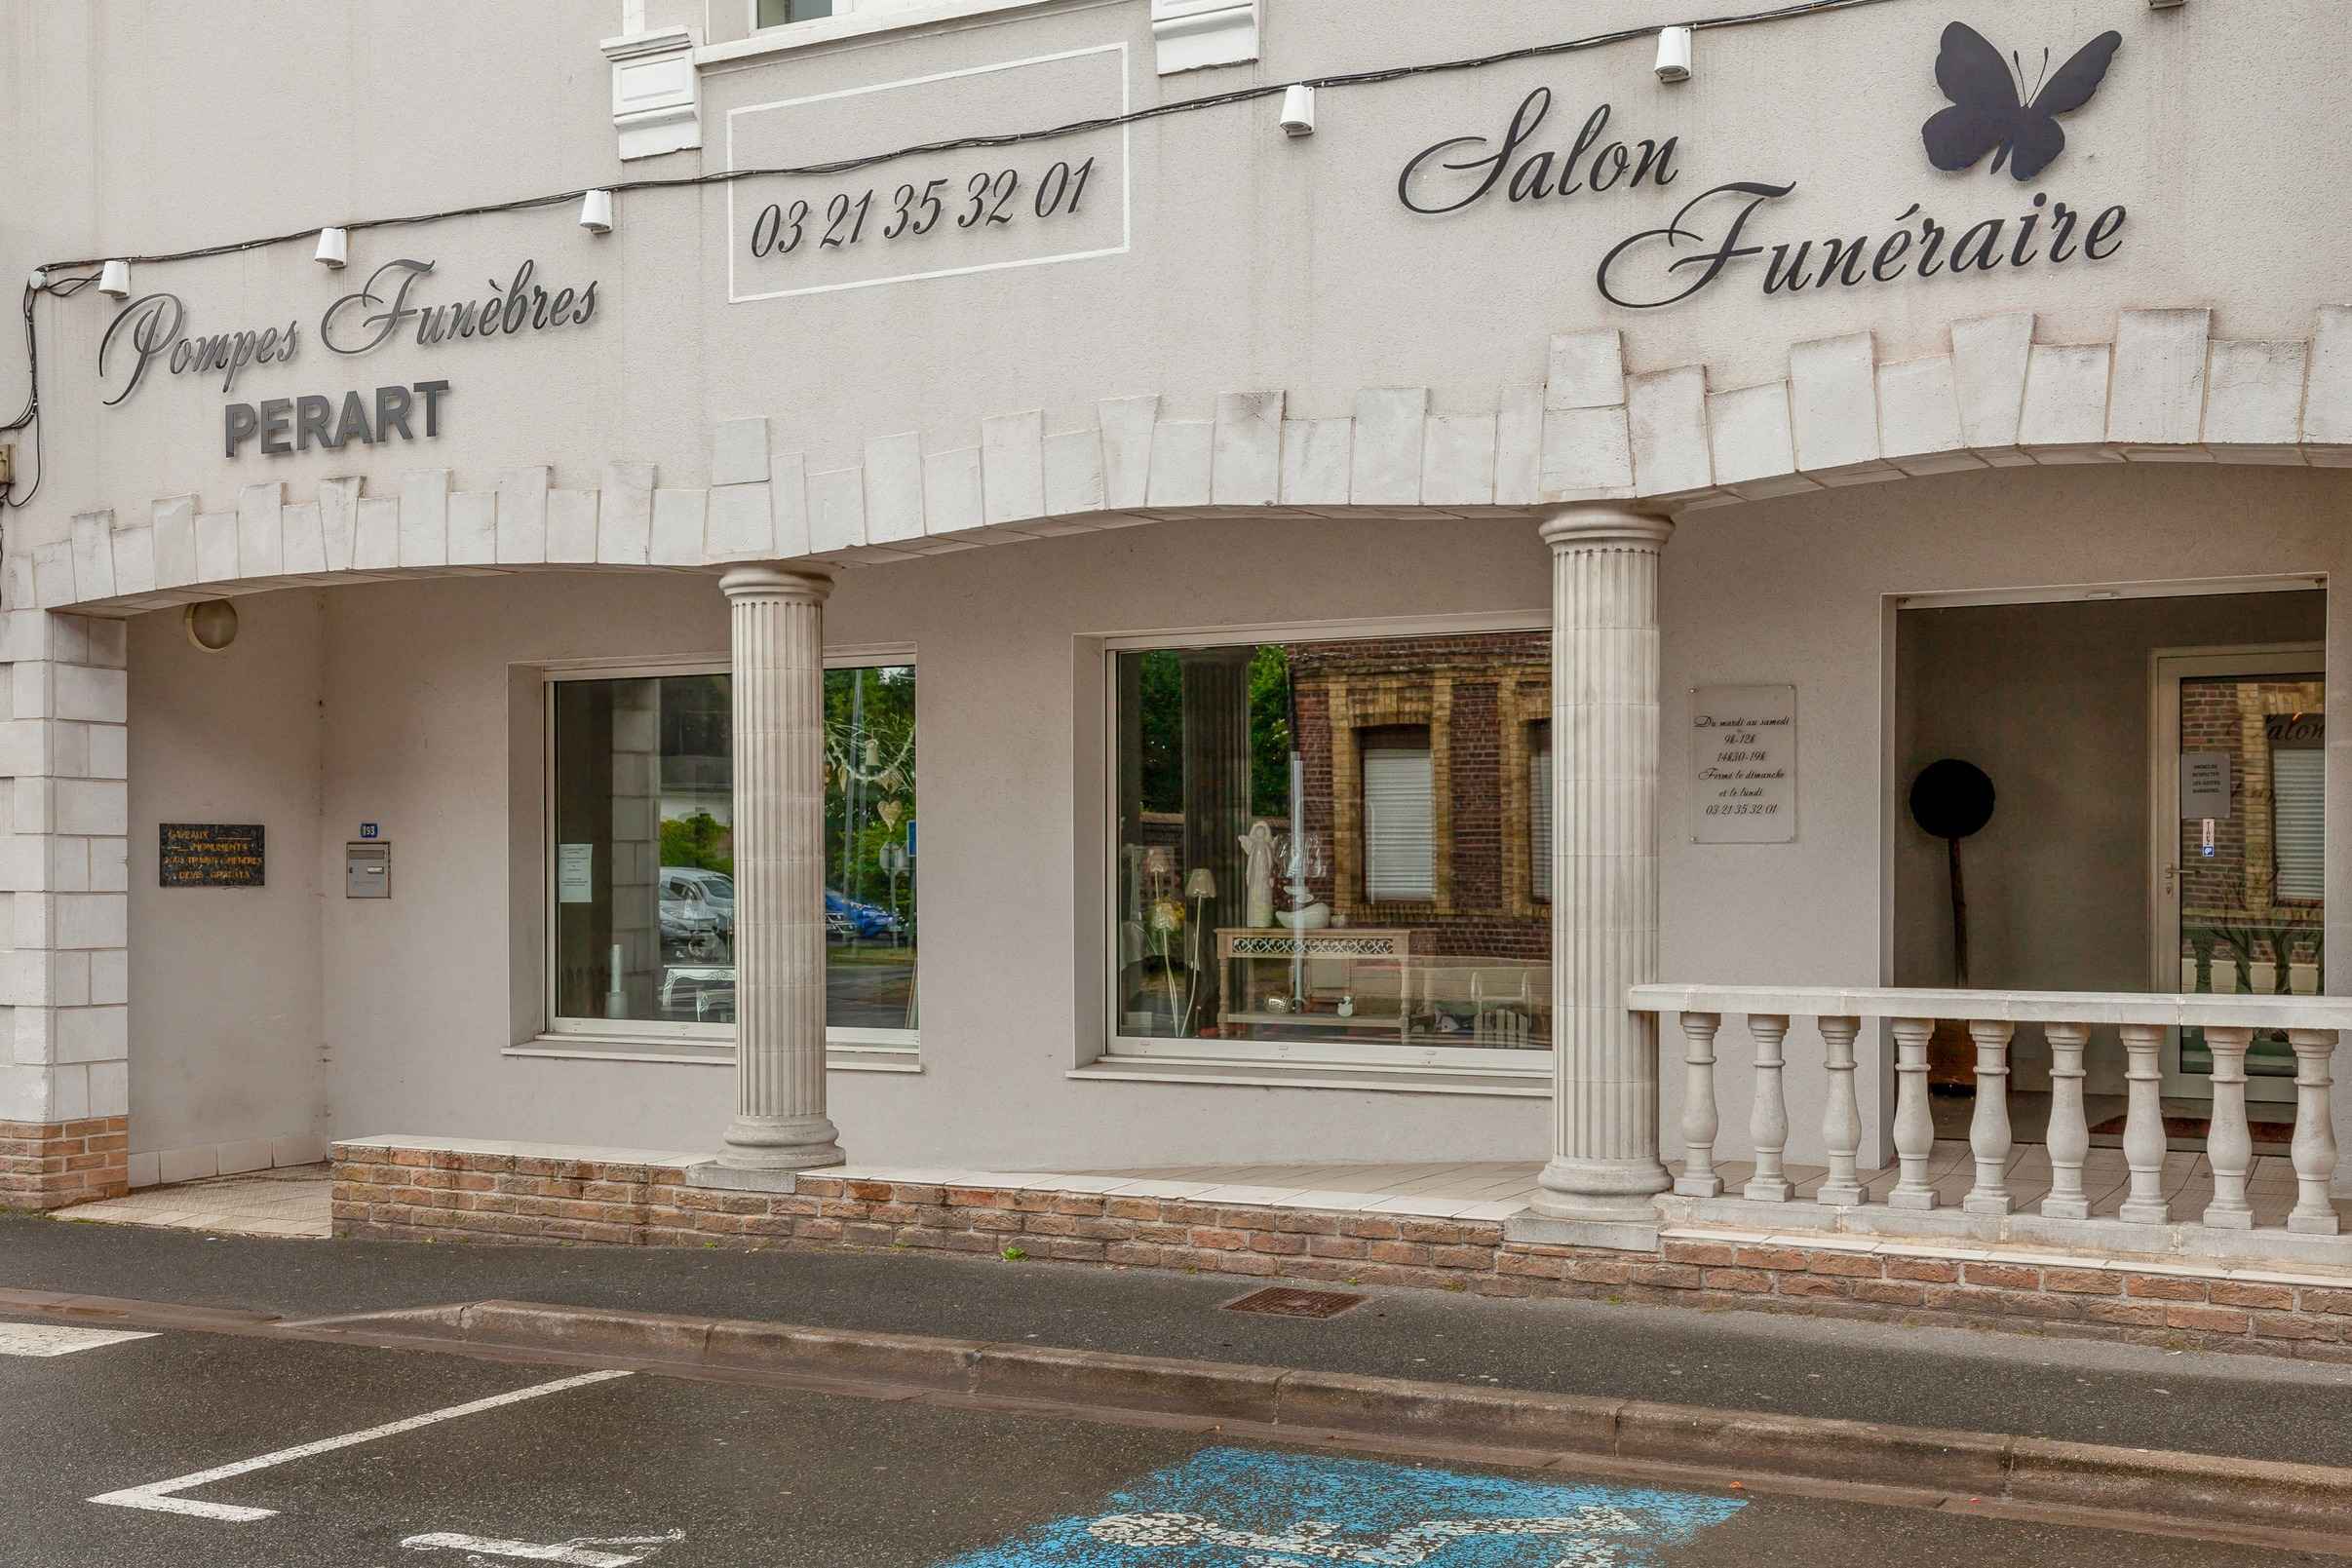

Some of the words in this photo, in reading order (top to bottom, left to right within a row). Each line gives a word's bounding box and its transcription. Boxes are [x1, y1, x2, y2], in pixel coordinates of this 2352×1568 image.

[1399, 86, 1678, 214] Salon
[751, 200, 809, 258] 03
[820, 189, 874, 249] 21
[883, 178, 949, 240] 35
[957, 169, 1019, 229] 32
[1034, 156, 1096, 218] 01
[1597, 180, 2127, 309] Funéraire
[99, 293, 298, 406] Pompes
[321, 258, 599, 354] Funèbres
[225, 379, 450, 459] PERART
[1693, 716, 1716, 728] Du
[1719, 717, 1745, 727] mardi
[1759, 715, 1791, 727] samedi
[1706, 805, 1719, 816] 03
[1721, 804, 1733, 815] 21
[1734, 803, 1748, 815] 35
[1749, 803, 1763, 815] 32
[1764, 803, 1778, 815] 01
[1729, 786, 1738, 797] le
[1740, 786, 1763, 796] lundi
[1735, 770, 1744, 779] le
[1746, 768, 1785, 780] dimanche
